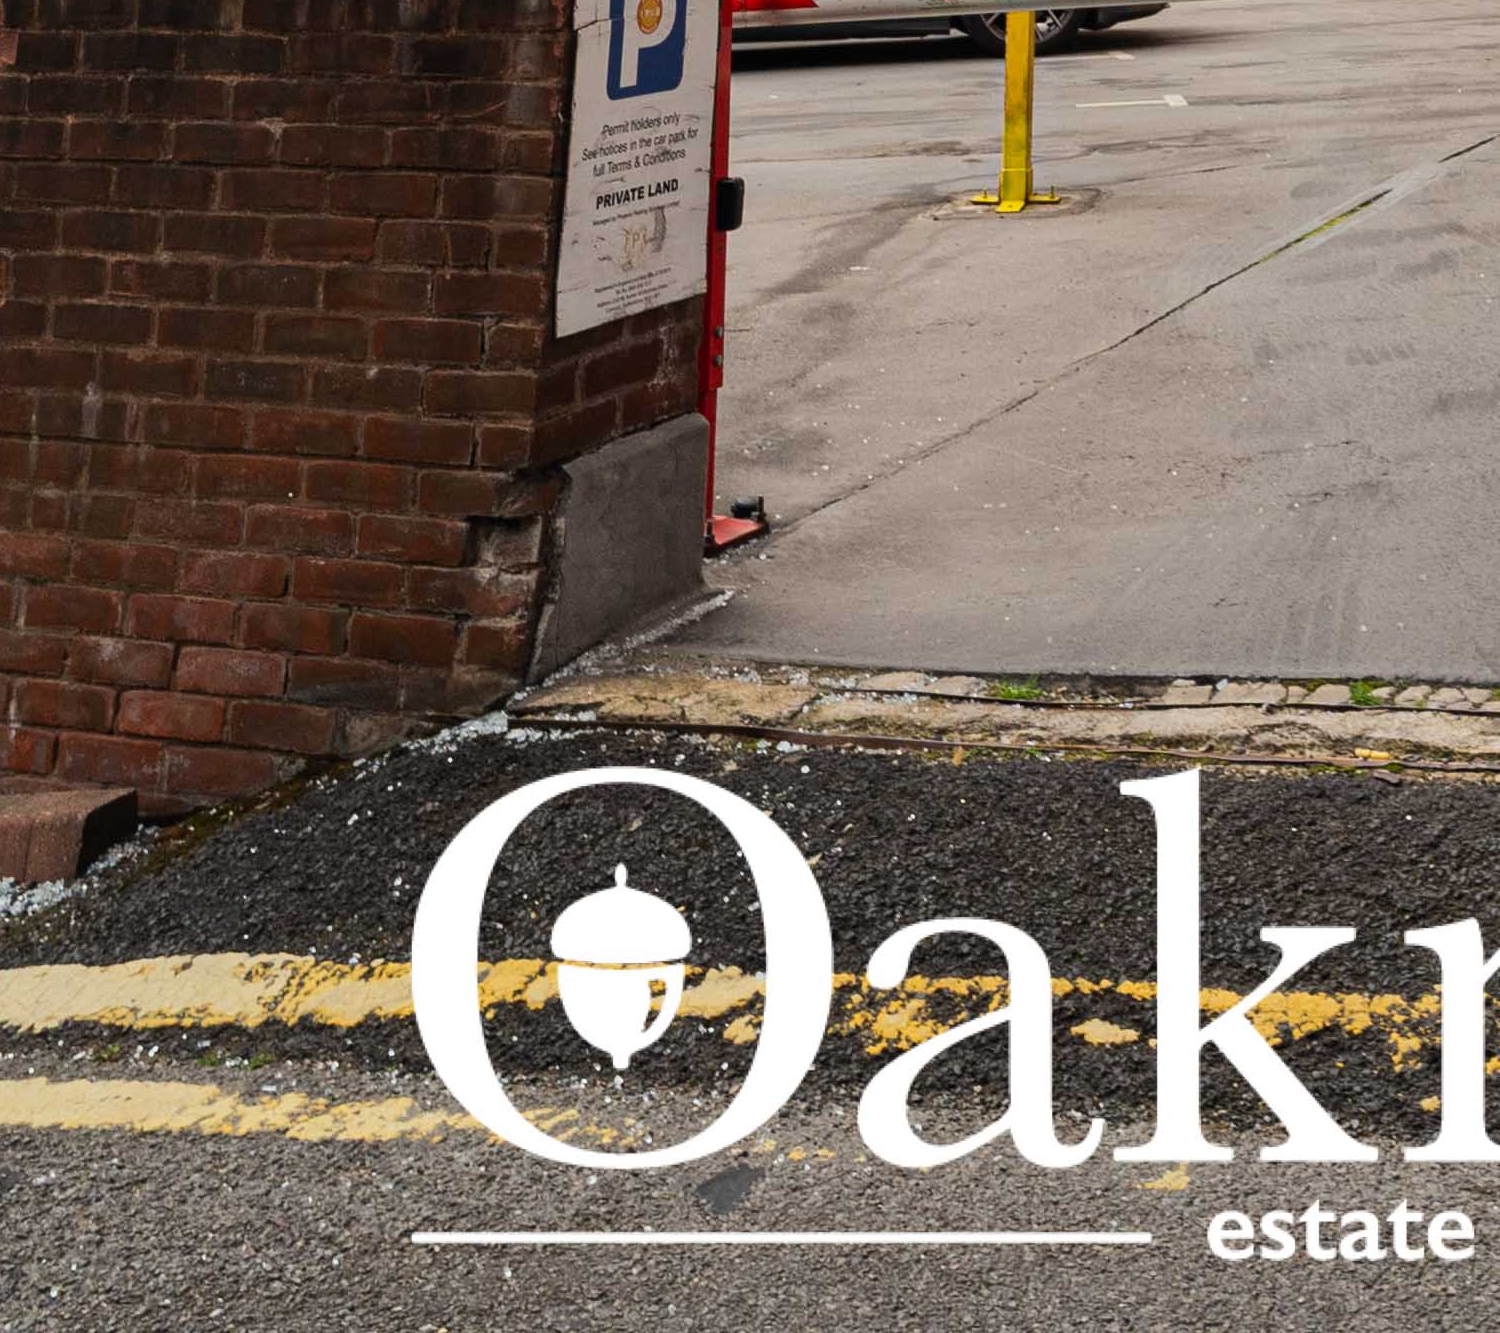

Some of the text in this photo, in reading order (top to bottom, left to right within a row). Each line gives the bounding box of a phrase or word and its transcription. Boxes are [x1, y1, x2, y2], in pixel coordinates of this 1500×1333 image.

[601, 112, 680, 136] Permit holders only
[582, 149, 597, 161] See
[599, 142, 628, 157] notices
[630, 139, 637, 150] in
[639, 137, 652, 148] the
[653, 134, 666, 146] car
[688, 127, 699, 139] for
[593, 149, 686, 177] full Terms & Conditions
[596, 178, 679, 210] PRIVATE LAND
